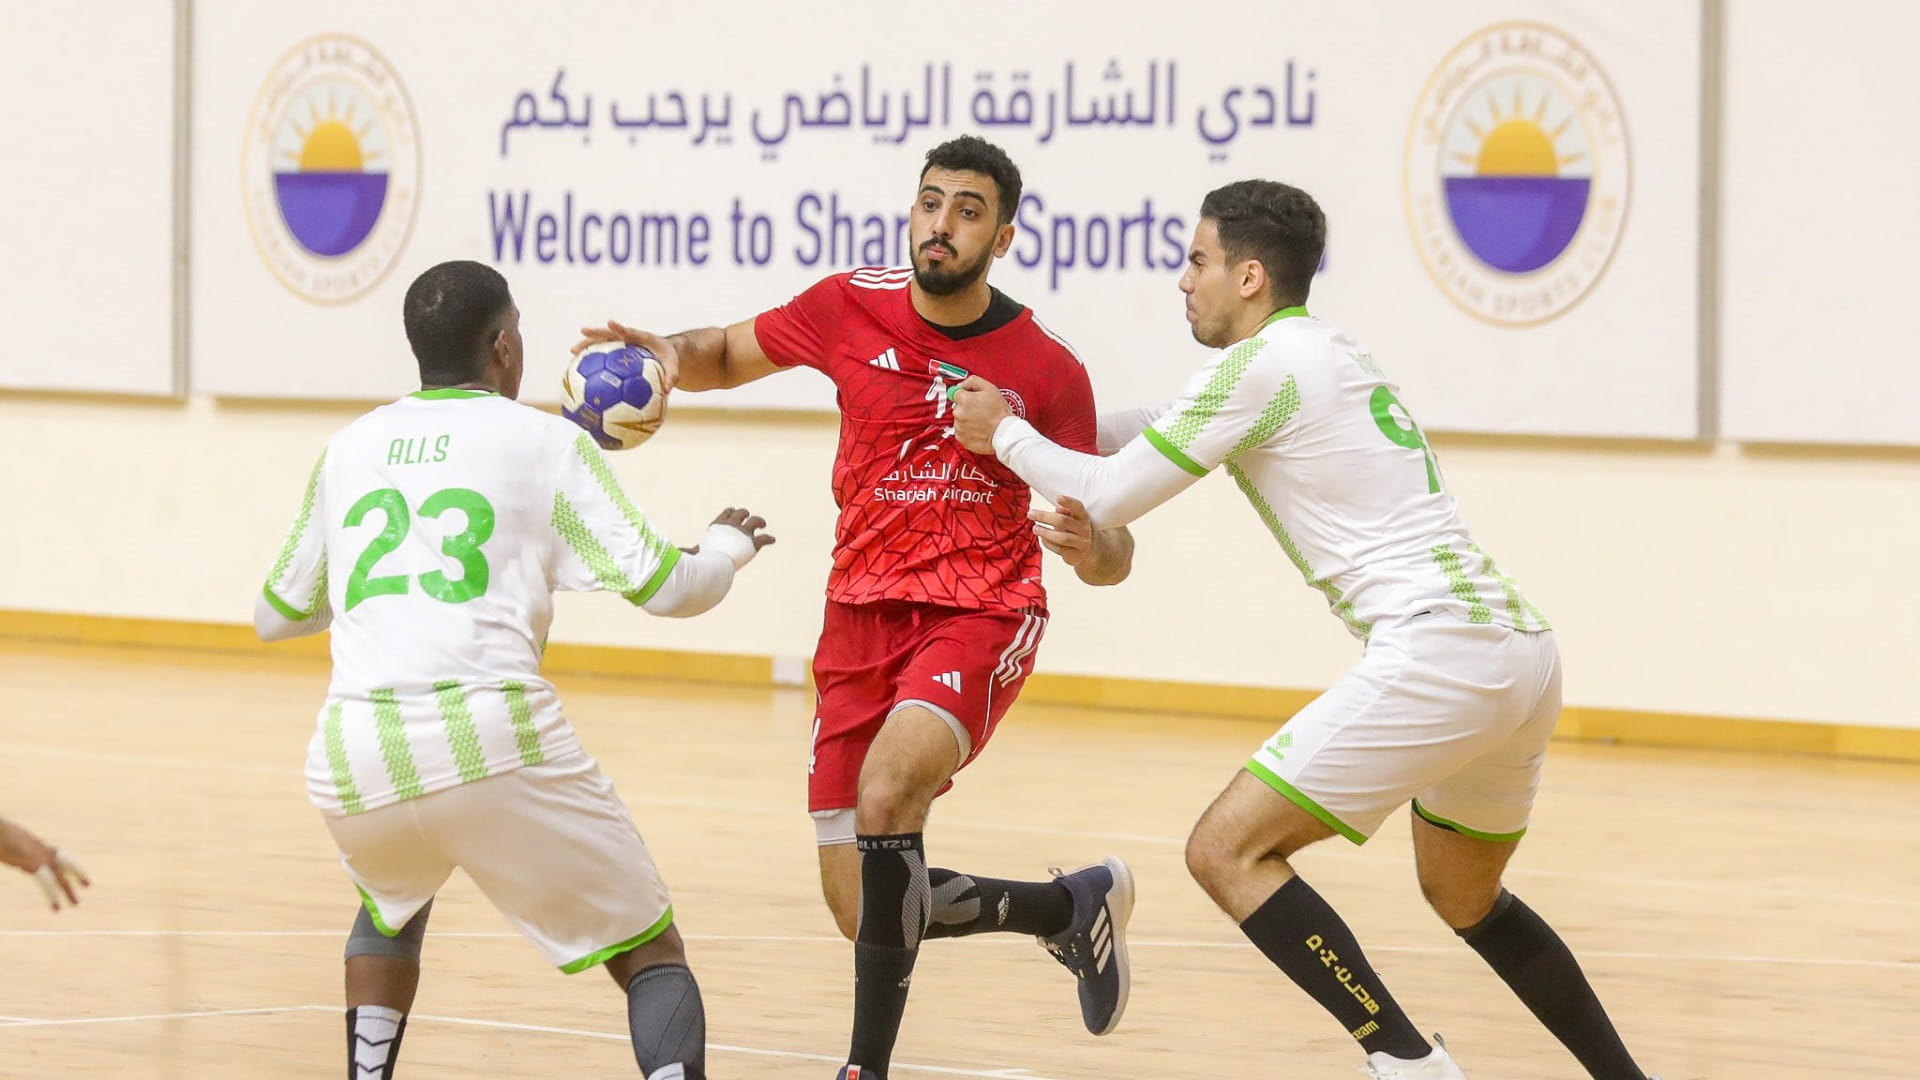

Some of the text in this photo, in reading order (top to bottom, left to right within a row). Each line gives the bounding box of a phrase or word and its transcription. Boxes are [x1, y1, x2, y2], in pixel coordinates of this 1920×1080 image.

[500, 68, 592, 156] بكم
[610, 92, 732, 146] يرحب
[750, 64, 951, 161] الرياضي
[970, 59, 1176, 145] الشارقة
[1197, 61, 1317, 161] نادي
[488, 191, 711, 267] Welcome
[730, 199, 774, 267] to
[794, 192, 909, 267] Shar
[1015, 193, 1187, 291] Sports
[387, 434, 450, 466] ALI.S
[874, 484, 994, 504] Sharjah Airport
[343, 487, 496, 613] 23
